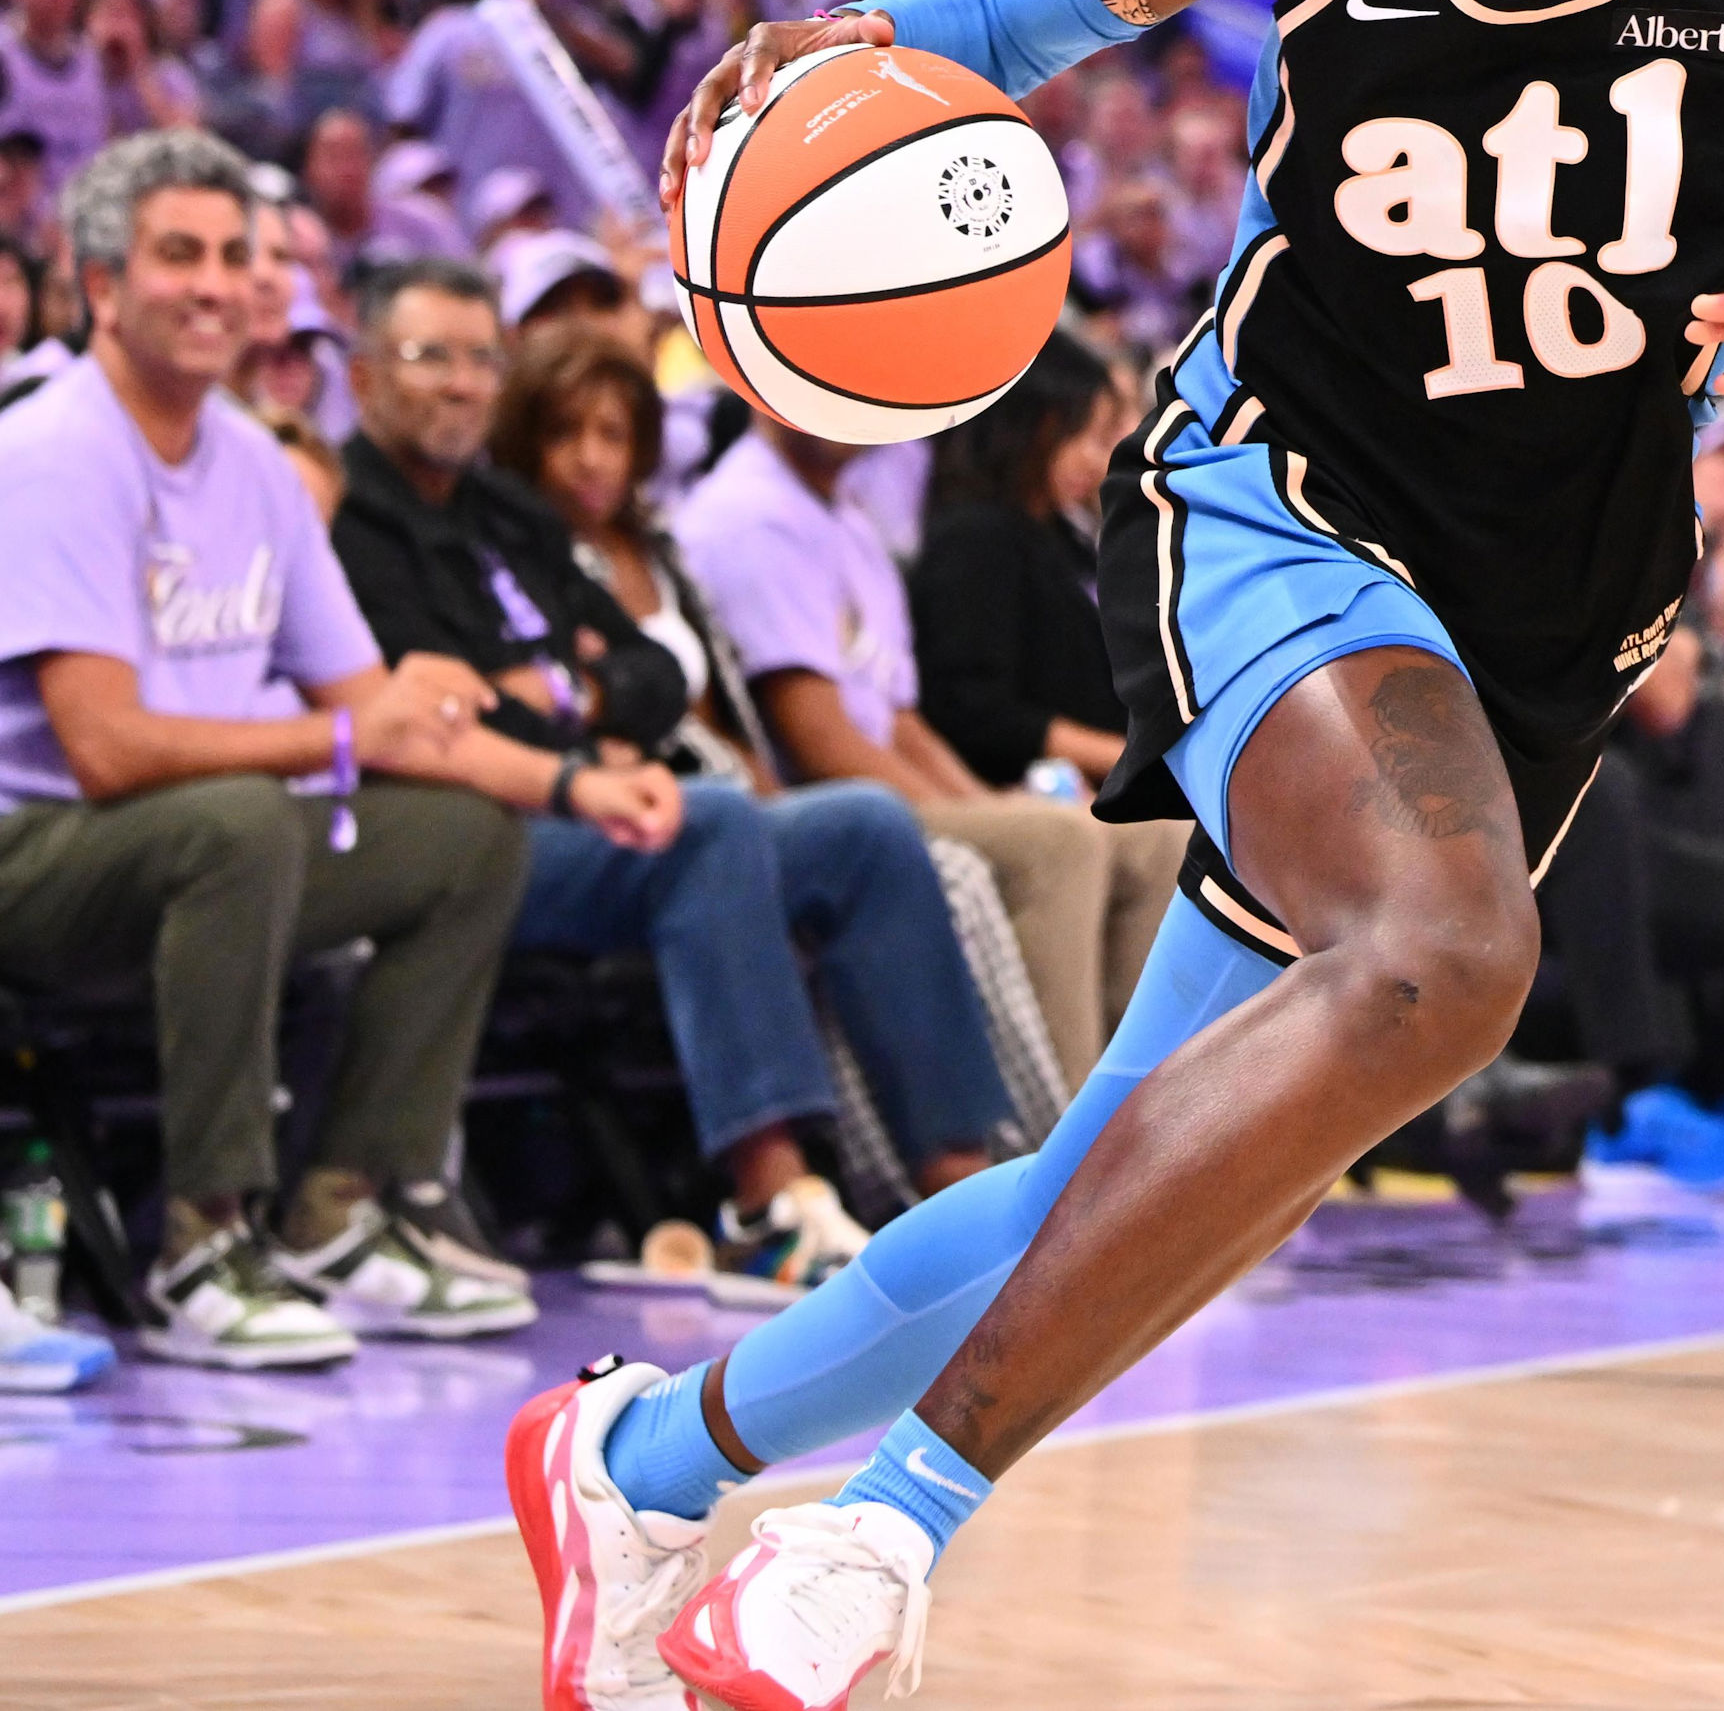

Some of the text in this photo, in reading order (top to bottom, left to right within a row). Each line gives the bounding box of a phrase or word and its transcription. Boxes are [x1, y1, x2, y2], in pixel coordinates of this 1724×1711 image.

[803, 89, 882, 145] FINALS BALL
[806, 89, 863, 129] OFFICIAL
[1334, 57, 1688, 275] atl
[1406, 261, 1647, 401] 10
